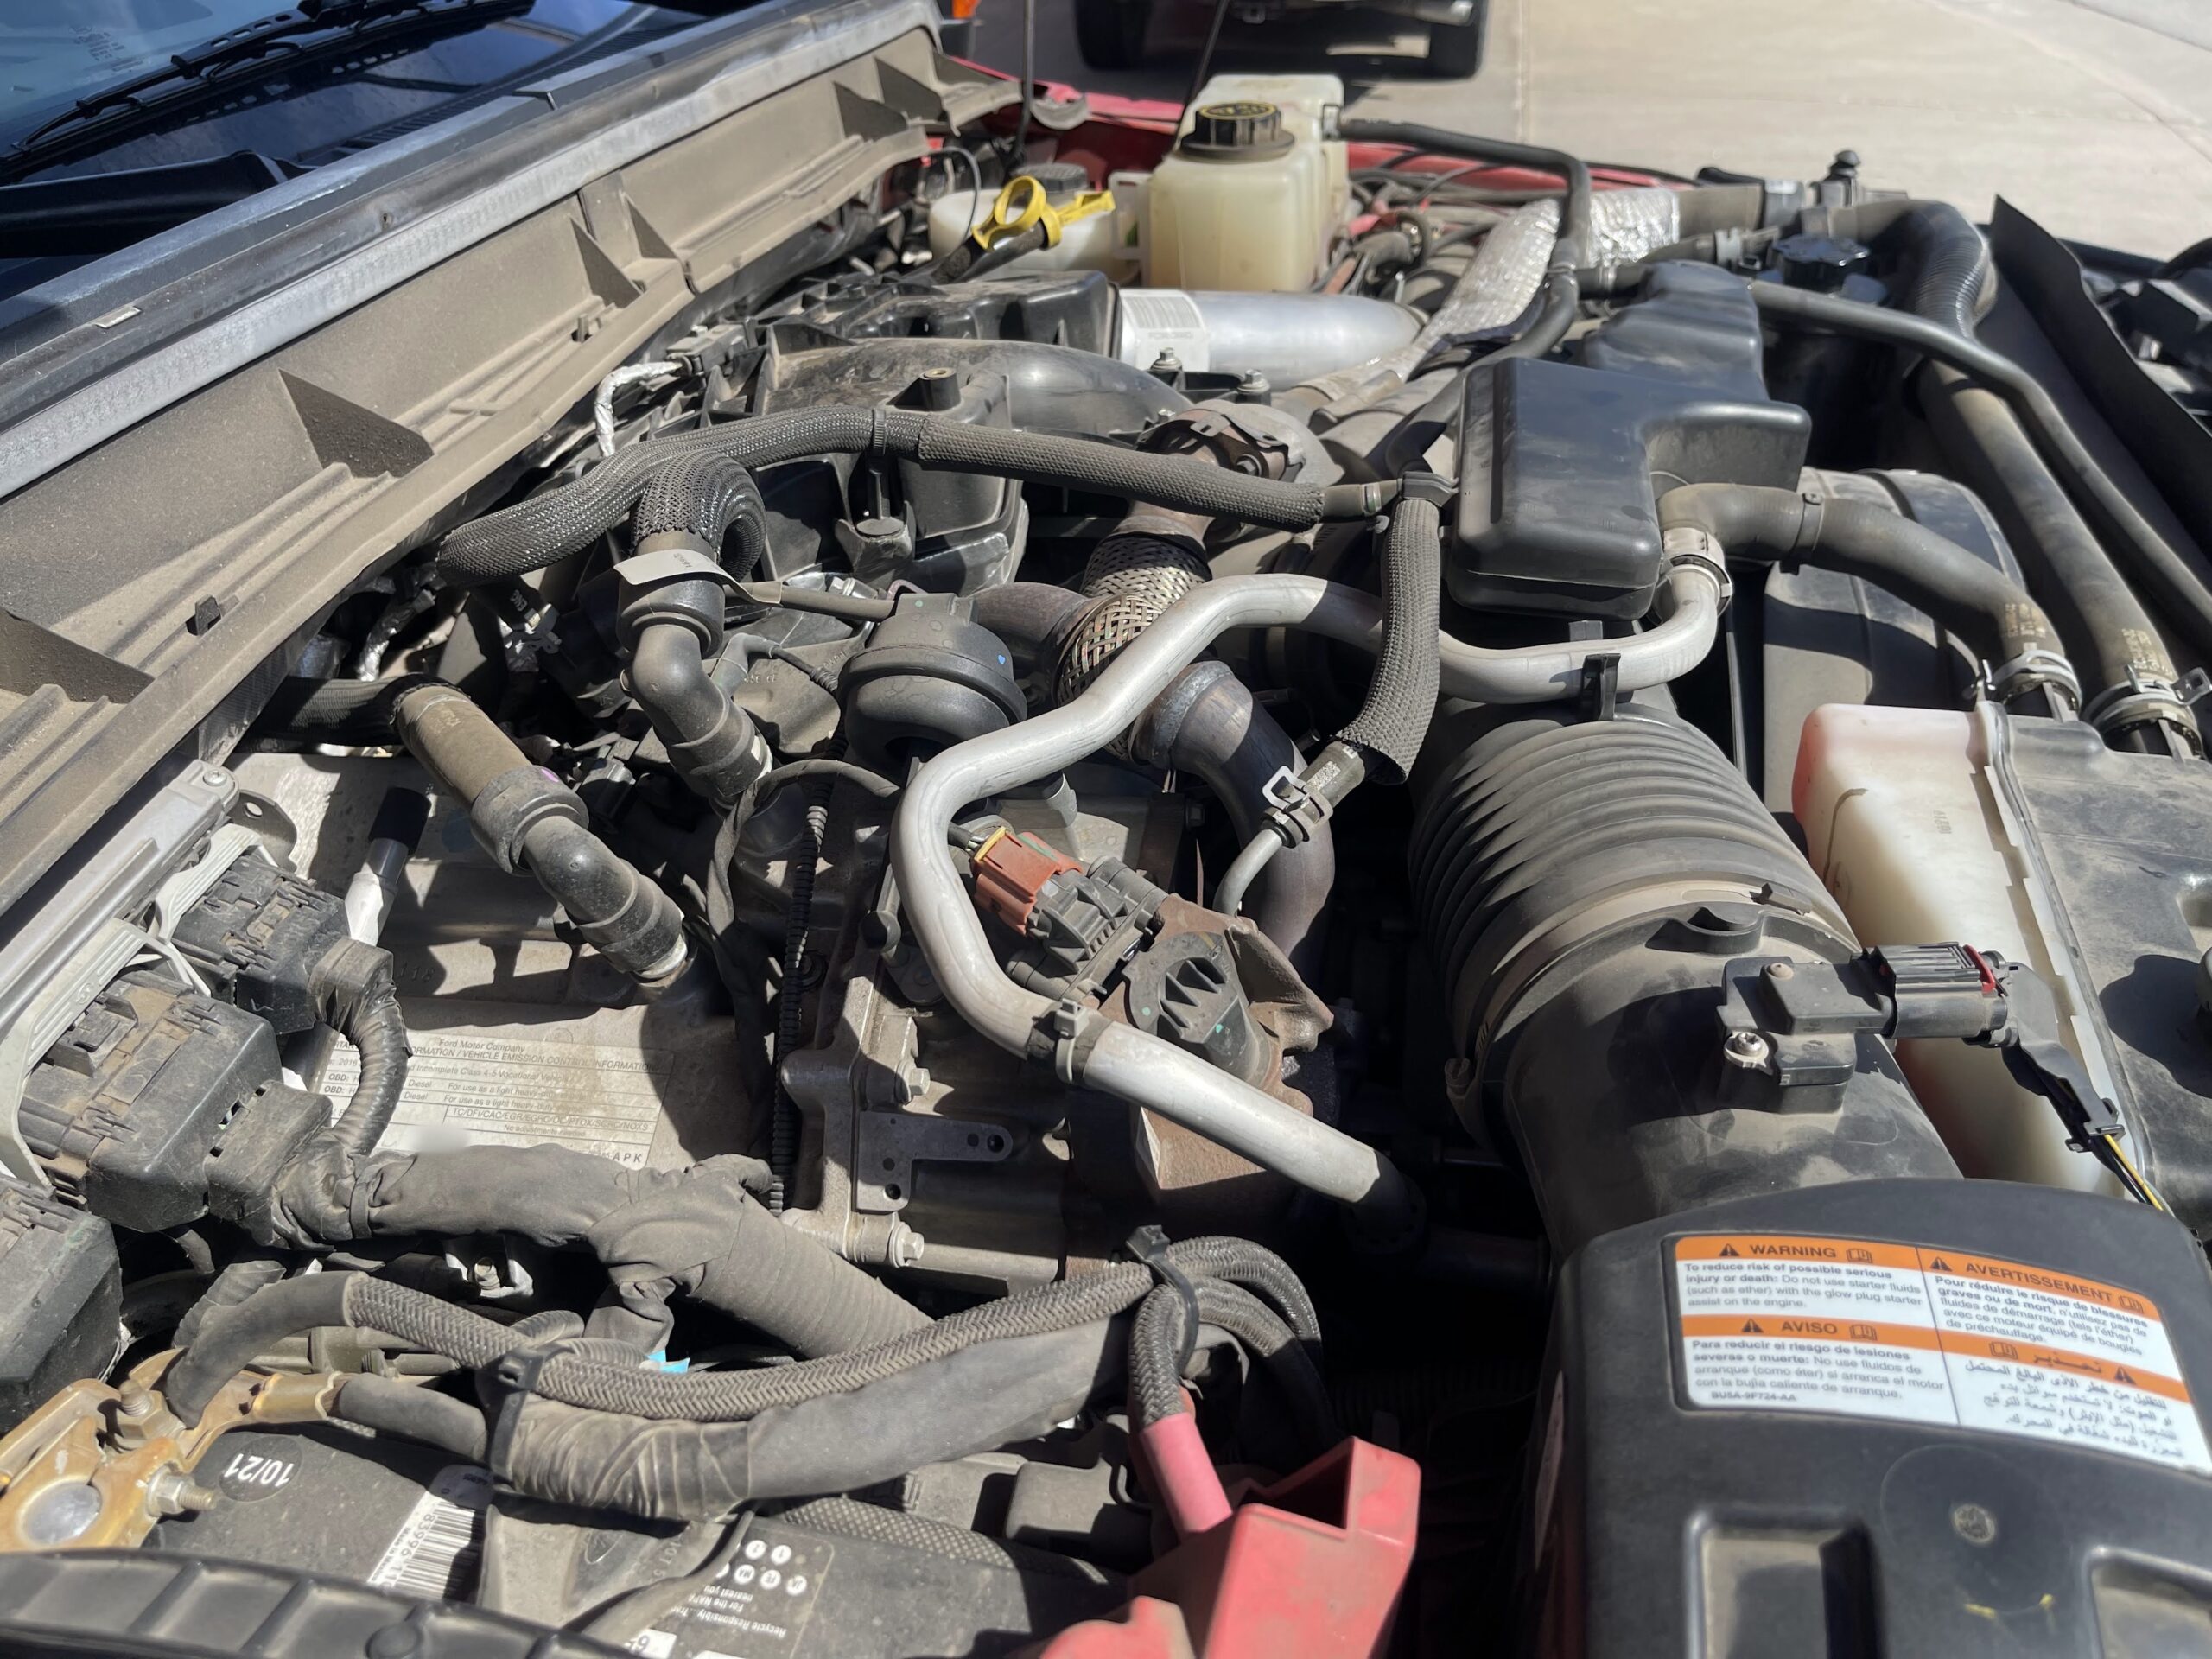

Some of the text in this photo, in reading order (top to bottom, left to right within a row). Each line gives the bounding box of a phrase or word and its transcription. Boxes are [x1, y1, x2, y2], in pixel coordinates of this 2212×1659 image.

[438, 1039, 525, 1053] Ford Motor Company
[463, 1050, 500, 1060] VEHICLE
[501, 1053, 545, 1064] EMISSION
[547, 1055, 594, 1067] CONTROL
[328, 1073, 350, 1082] OBD:
[416, 1064, 459, 1076] Incomplete
[460, 1067, 482, 1077] Class
[499, 1071, 541, 1081] Vocational
[324, 1085, 346, 1095] OBD:
[407, 1078, 433, 1088] Diesel
[448, 1081, 462, 1090] For
[462, 1084, 477, 1092] use
[496, 1086, 514, 1096] light
[404, 1090, 429, 1101] Diesel
[443, 1093, 457, 1103] For
[458, 1096, 474, 1105] use
[492, 1098, 510, 1109] light
[504, 1124, 515, 1133] No
[1749, 1244, 1837, 1259] WARNING
[1684, 1262, 1892, 1279] To reduce risk of possible serious
[1686, 1274, 1719, 1284] injury
[1740, 1274, 1778, 1283] death:
[1782, 1274, 1799, 1284] Do
[1802, 1276, 1821, 1286] not
[1823, 1278, 1846, 1287] use
[1848, 1279, 1887, 1291] starter
[1890, 1281, 1922, 1294] fluids
[1966, 1262, 2113, 1303] AVERTISSEMENT
[1687, 1286, 1718, 1295] (such
[1738, 1286, 1773, 1296] ether)
[1776, 1286, 1799, 1296] with
[1802, 1287, 1821, 1297] the
[1824, 1288, 1852, 1299] glow
[1855, 1291, 1882, 1303] plug
[1884, 1294, 1923, 1306] starter
[1688, 1297, 1807, 1308] assist on the engine.
[1935, 1275, 2149, 1328] Pour réduire le risque de blessures
[1937, 1287, 1981, 1300] graves
[1984, 1294, 2001, 1304] ou
[2004, 1296, 2020, 1306] de
[2110, 1321, 2132, 1333] pas
[2133, 1327, 2148, 1338] de
[1940, 1296, 1980, 1311] fluides
[1982, 1303, 1999, 1314] de
[2001, 1306, 2065, 1326] démarrage
[1780, 1320, 1839, 1335] AVISO
[1943, 1308, 1974, 1320] avec
[1975, 1313, 1991, 1323] ce
[1993, 1314, 2035, 1331] moteur
[2081, 1332, 2096, 1344] de
[2097, 1336, 2143, 1357] bougies
[1945, 1318, 1962, 1329] de
[1692, 1339, 1911, 1361] Para reducir el riesgo de lesiones
[1694, 1353, 1923, 1376] severas o muerte: No use fluidos de
[1694, 1365, 1750, 1376] arranque
[1751, 1364, 1792, 1377] (como
[1827, 1370, 1839, 1380] si
[1841, 1371, 1890, 1385] arranca
[1892, 1376, 1905, 1387] el
[1907, 1378, 1945, 1391] motor
[1694, 1377, 1719, 1388] con
[1720, 1377, 1733, 1388] la
[1769, 1379, 1819, 1391] caliente
[1821, 1382, 1838, 1393] de
[1840, 1384, 1904, 1400] arranque.
[223, 1452, 295, 1488] 10/21
[713, 1597, 728, 1610] the
[720, 1587, 754, 1604] nearest
[728, 1600, 745, 1614] For
[750, 1621, 787, 1640] Recycle
